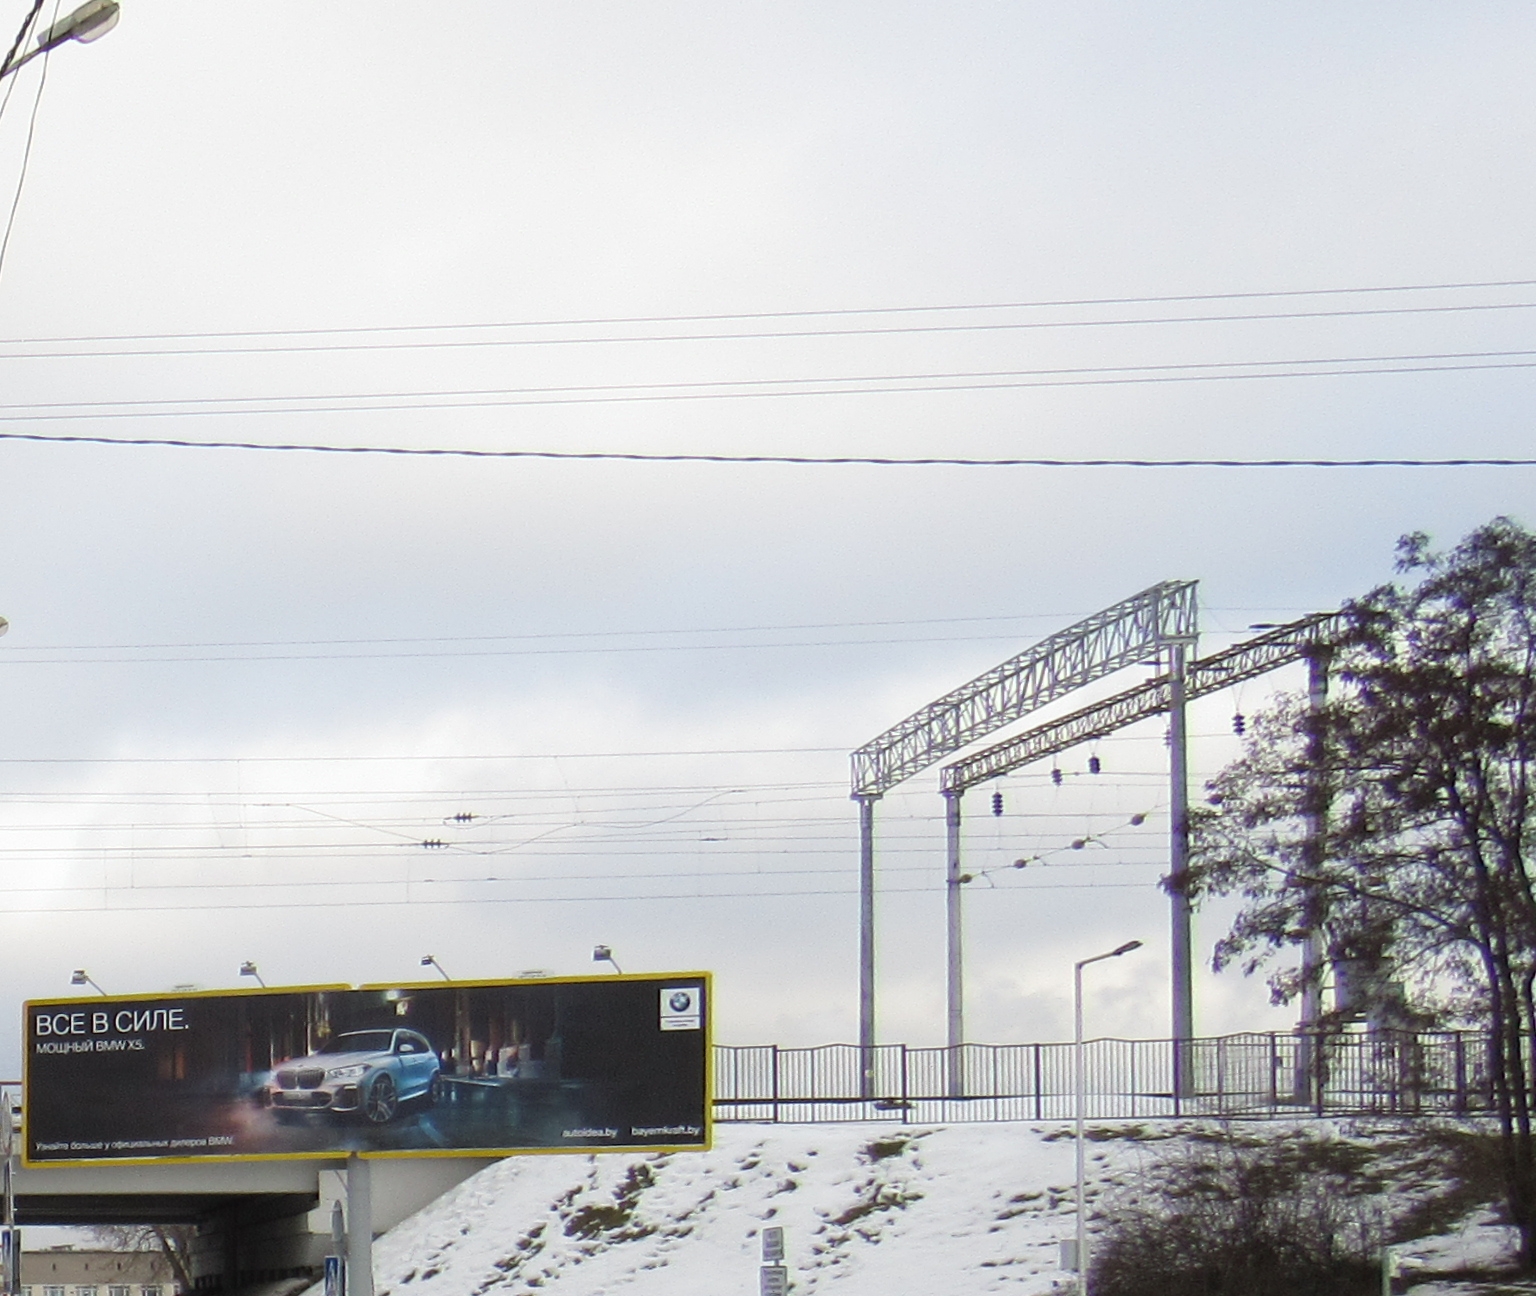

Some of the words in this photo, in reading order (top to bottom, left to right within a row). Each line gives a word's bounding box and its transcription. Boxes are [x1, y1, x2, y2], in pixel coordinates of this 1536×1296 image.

[36, 1013, 85, 1036] ВСЕ
[92, 1012, 109, 1034] В
[115, 1008, 189, 1032] СИЛЕ.
[36, 1039, 94, 1054] МОЩНЫЙ
[95, 1040, 127, 1052] BMW
